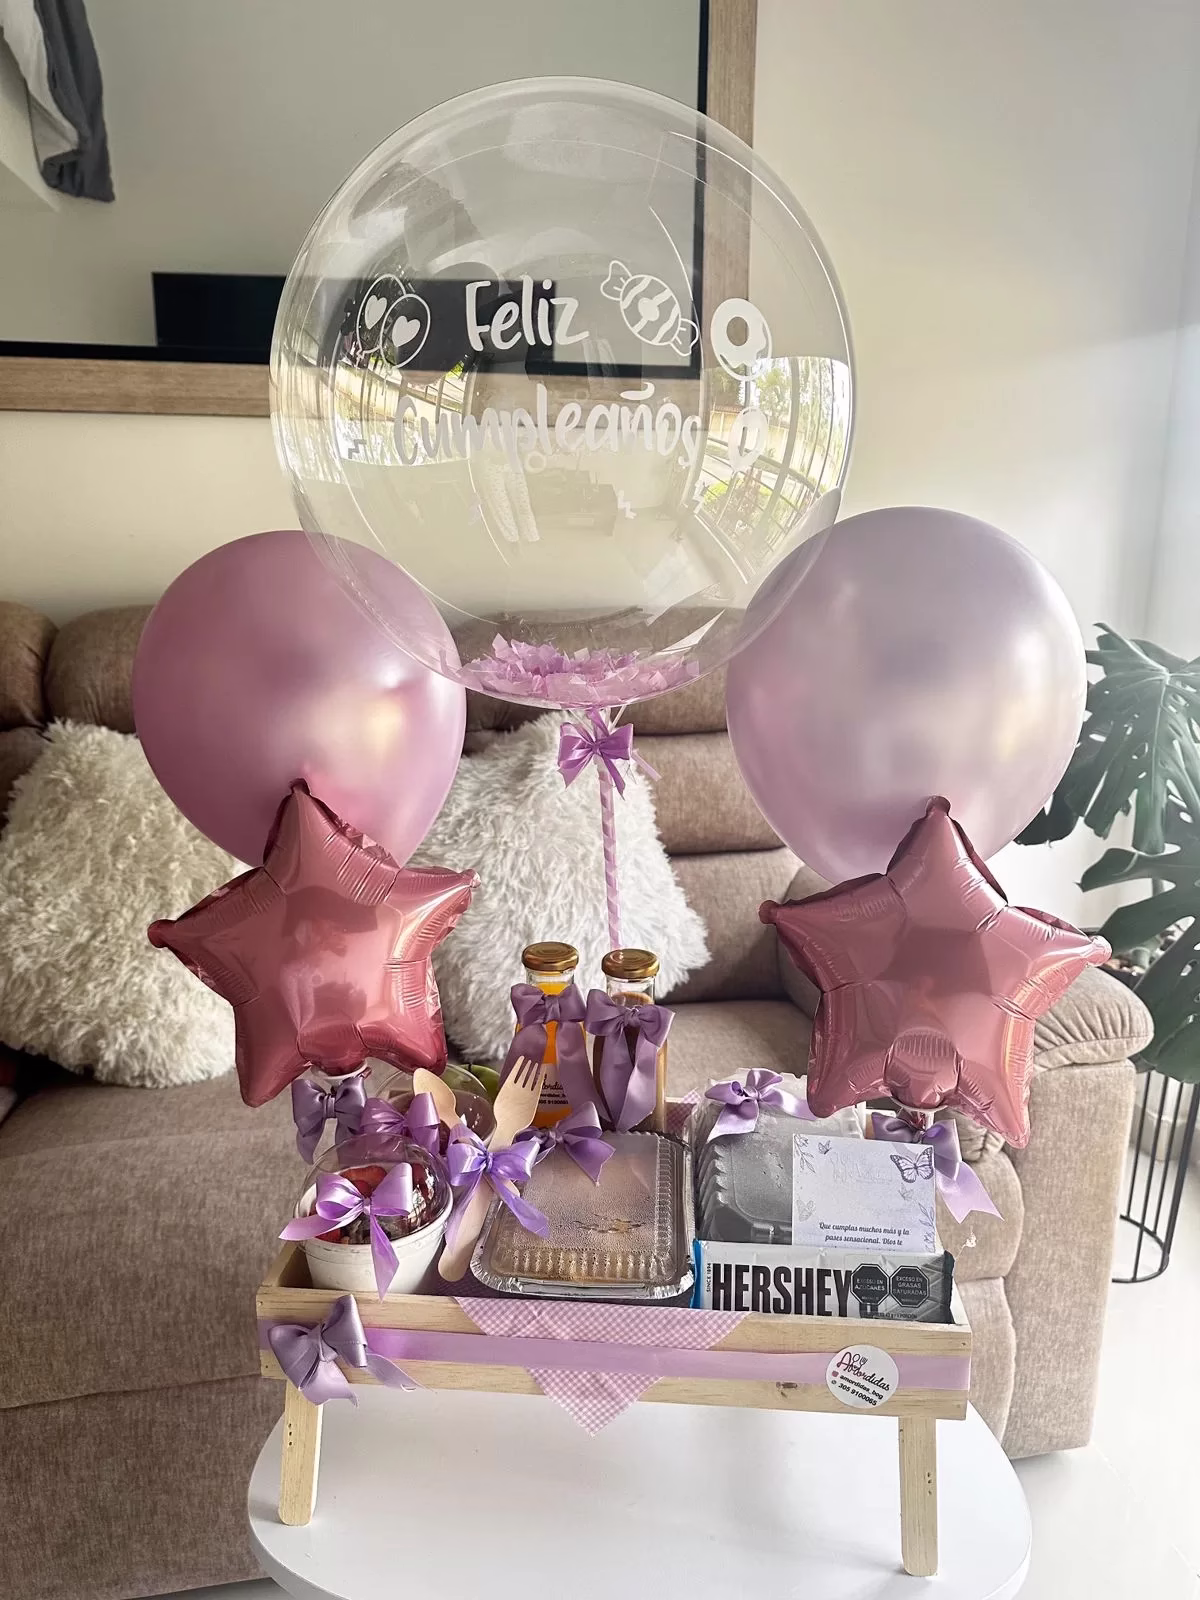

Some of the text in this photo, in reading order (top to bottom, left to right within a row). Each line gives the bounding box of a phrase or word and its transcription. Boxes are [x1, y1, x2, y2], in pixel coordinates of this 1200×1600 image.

[466, 274, 590, 351] Feliz
[393, 382, 702, 473] Cumpleaños
[819, 1221, 910, 1237] Que cumplas muchos más y la
[825, 1234, 843, 1242] pases
[843, 1235, 881, 1245] sensacional.
[712, 1263, 878, 1319] HERSHEY
[892, 1288, 927, 1296] SATURADAS
[838, 1382, 850, 1392] 305
